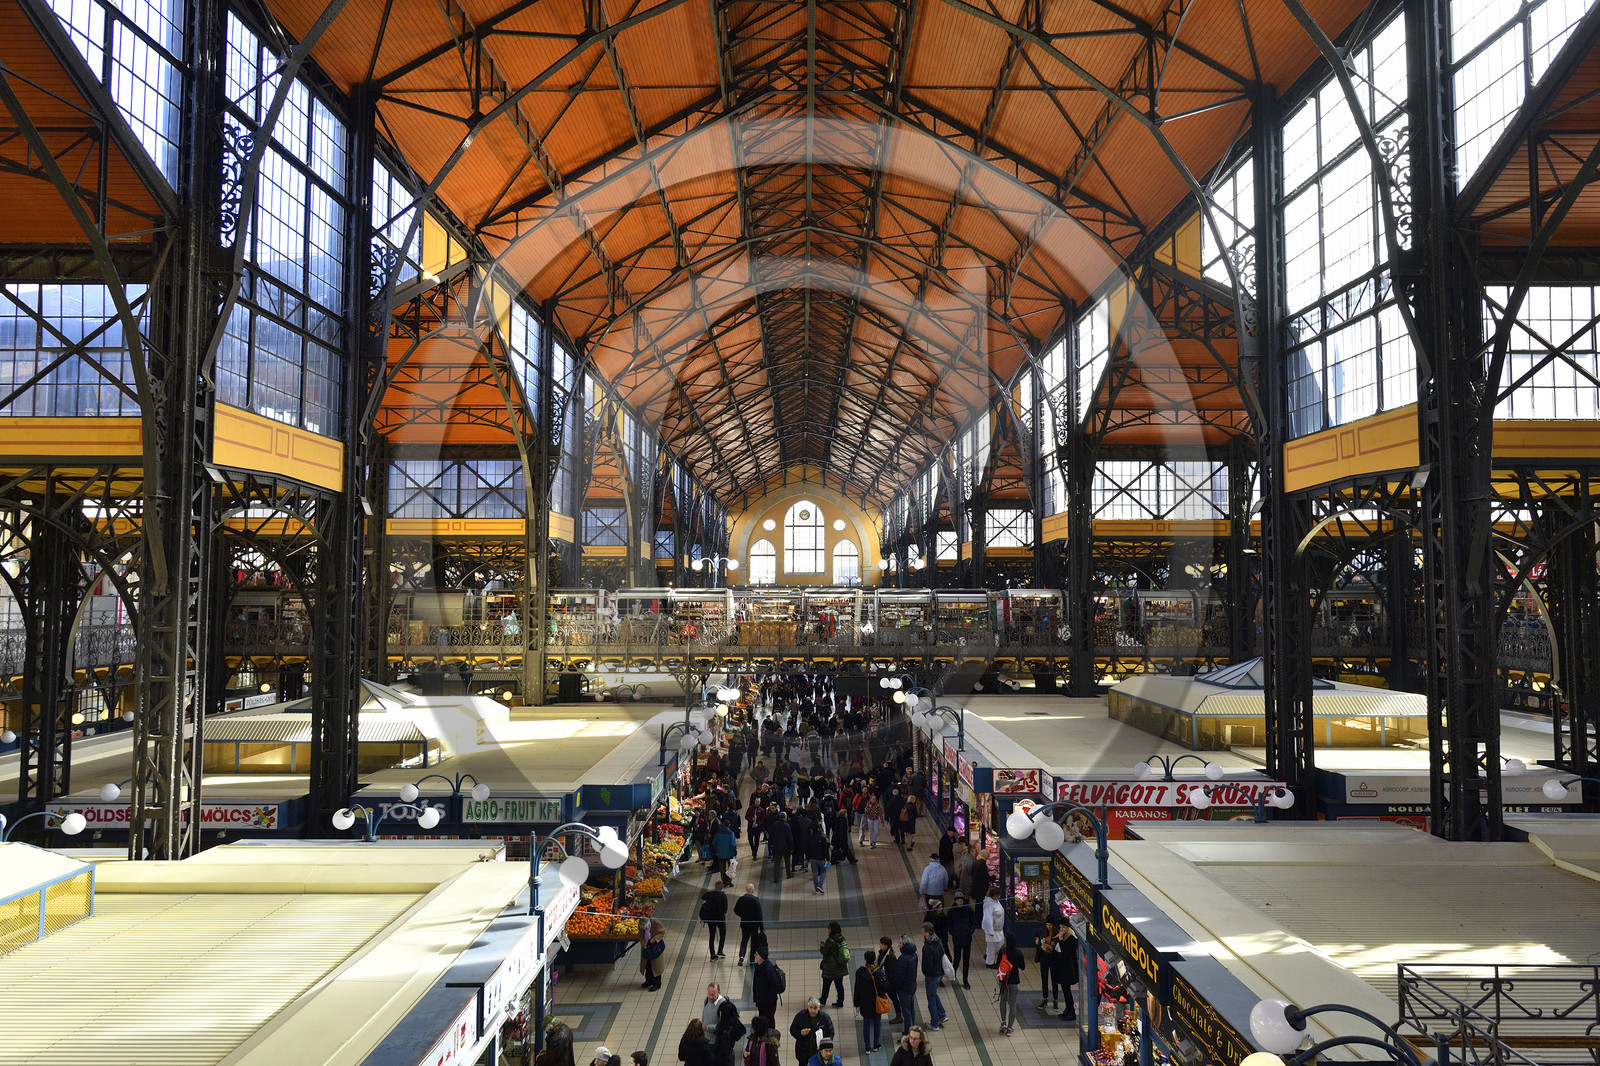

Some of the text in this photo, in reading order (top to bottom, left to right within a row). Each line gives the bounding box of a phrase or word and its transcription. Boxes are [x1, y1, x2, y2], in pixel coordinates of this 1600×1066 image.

[1058, 783, 1168, 805] FELVÁGOTT
[465, 799, 562, 822] AGRO-FRUIT KFT.
[1115, 810, 1168, 819] KABANOS
[1172, 984, 1213, 1038] Chocolate
[1216, 1030, 1223, 1048] &
